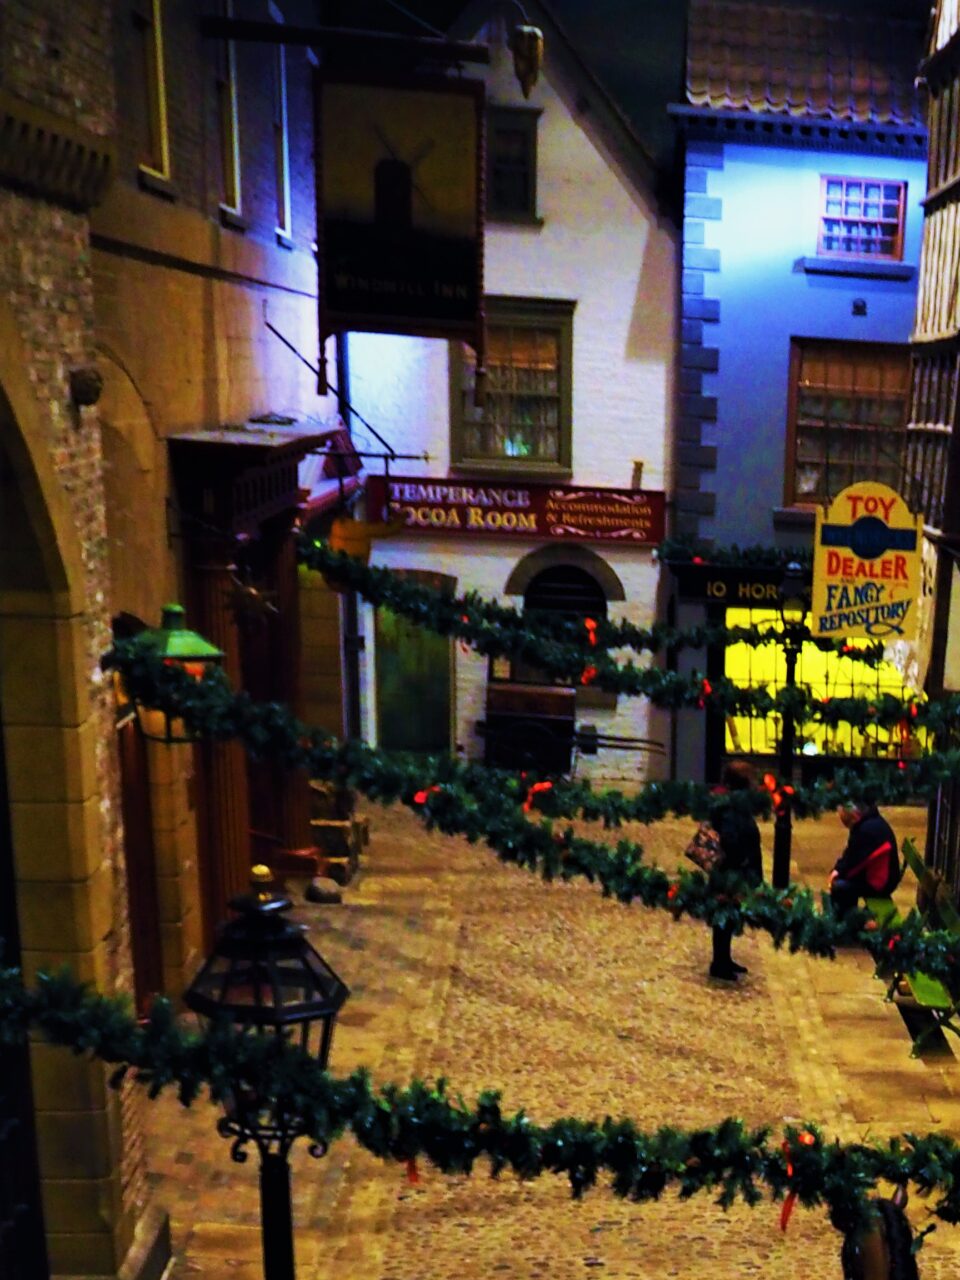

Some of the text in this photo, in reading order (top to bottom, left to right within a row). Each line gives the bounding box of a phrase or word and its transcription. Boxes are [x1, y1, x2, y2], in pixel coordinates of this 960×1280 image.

[390, 482, 530, 508] TEMPERANCE
[545, 499, 652, 515] Accommodation
[466, 507, 537, 532] ROOM
[562, 512, 652, 529] Refreshments
[847, 494, 897, 524] TOY
[826, 549, 909, 581] DEALER
[738, 582, 779, 600] HOR
[819, 598, 914, 636] REPOSITORY
